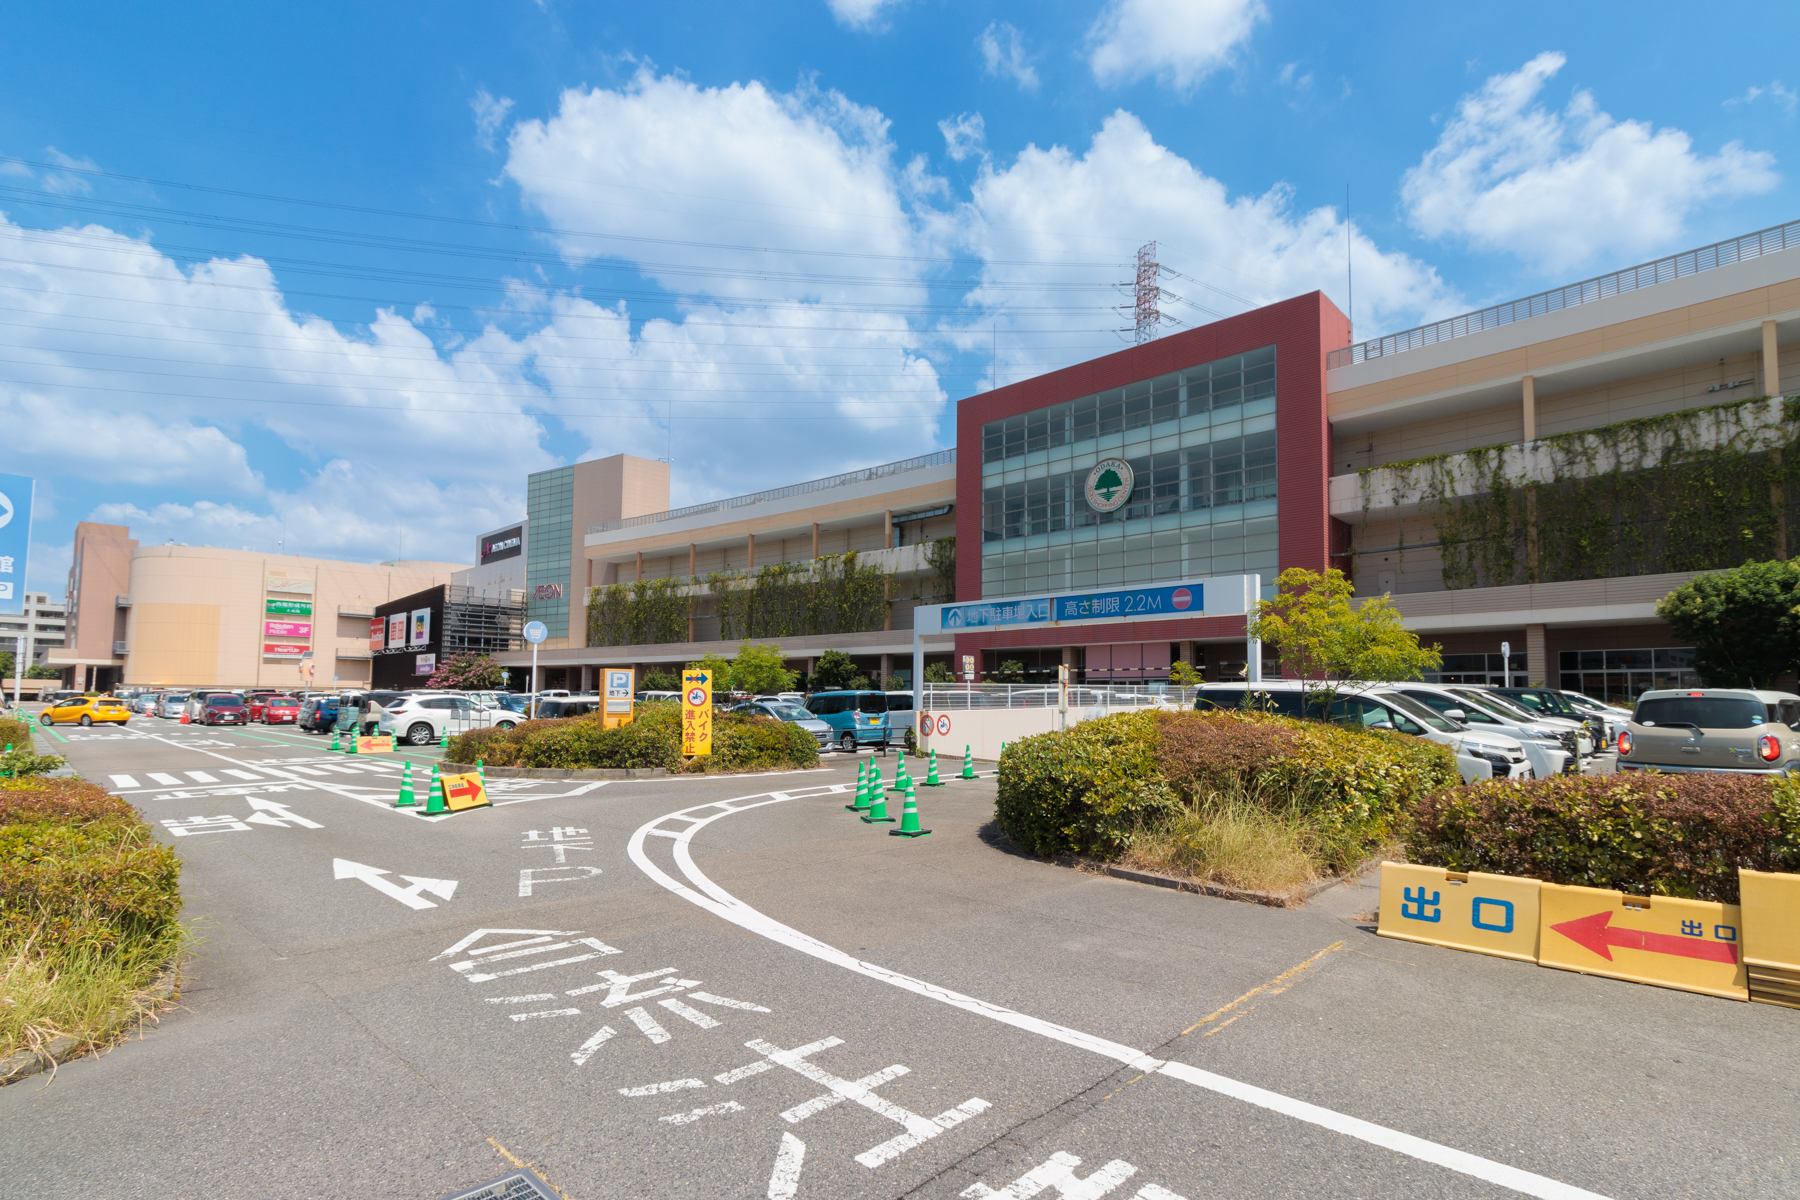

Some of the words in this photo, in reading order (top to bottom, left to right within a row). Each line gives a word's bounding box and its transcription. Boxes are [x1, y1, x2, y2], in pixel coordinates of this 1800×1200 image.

[1095, 461, 1121, 474] ODAKA
[1092, 499, 1119, 509] SHOPPING
[1117, 476, 1130, 503] CENTER
[967, 604, 1050, 623] 地下駐車場入口
[1064, 597, 1120, 616] 高さ制限
[1124, 595, 1162, 613] 2.2M
[298, 626, 309, 634] 3F
[612, 673, 627, 687] P
[684, 709, 696, 754] 進入禁止
[698, 709, 709, 742] バイク
[152, 783, 318, 801] 止まれ
[1401, 886, 1515, 934] 出口
[1681, 919, 1738, 942] 出口
